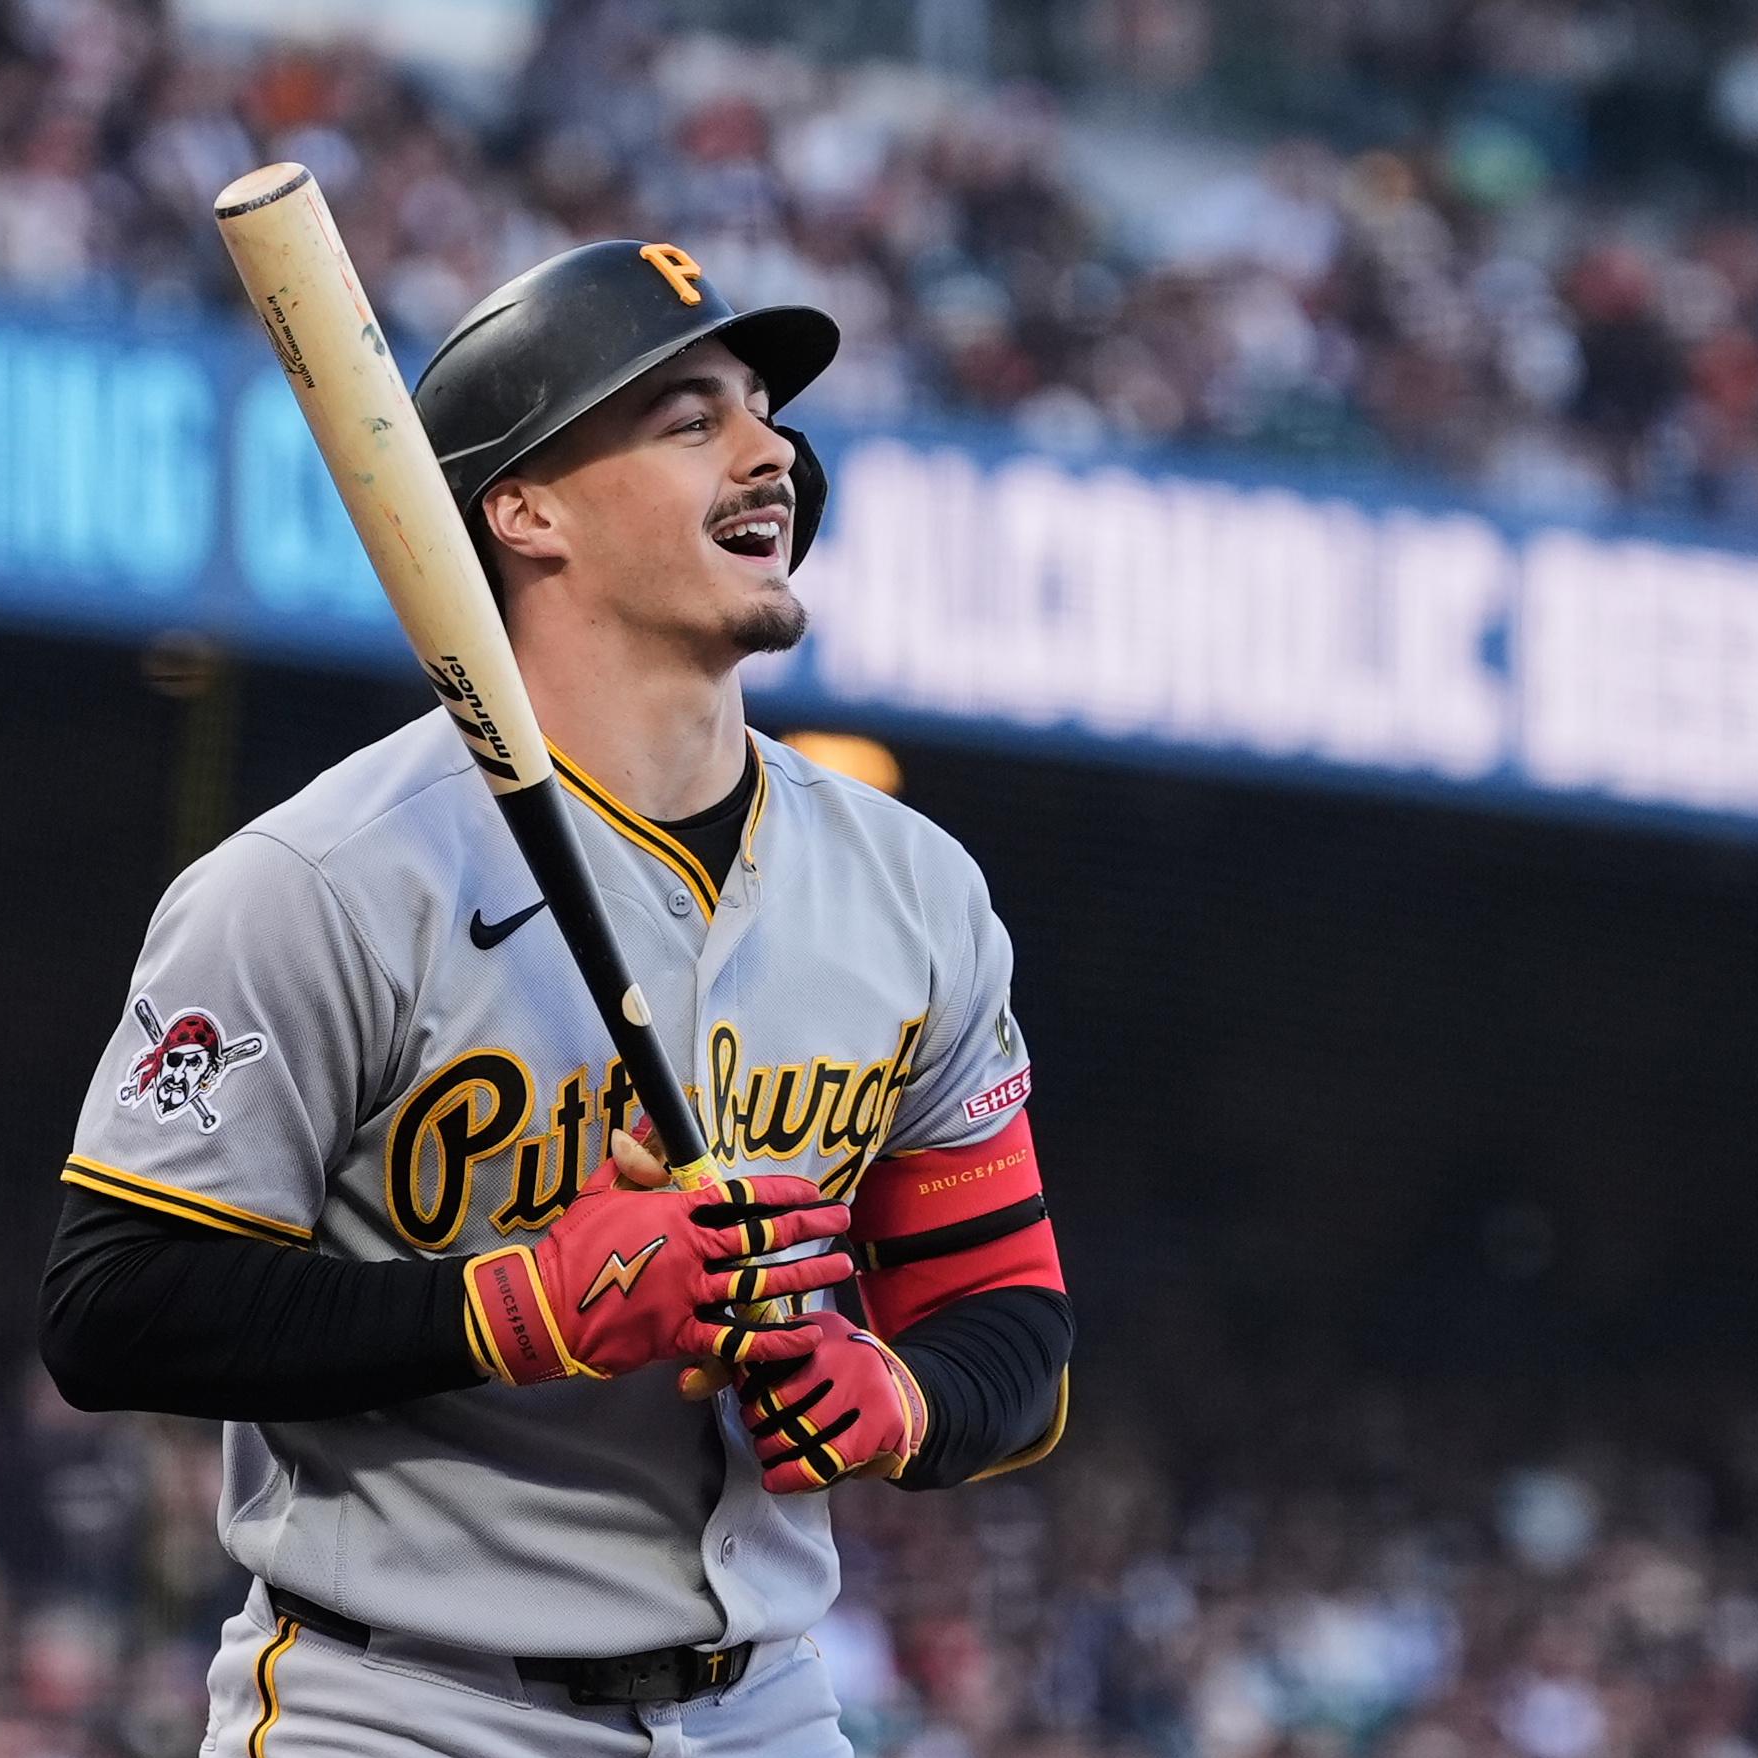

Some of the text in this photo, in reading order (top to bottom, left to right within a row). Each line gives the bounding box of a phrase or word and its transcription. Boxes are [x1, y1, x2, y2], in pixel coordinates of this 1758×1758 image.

[639, 243, 702, 306] P
[283, 325, 303, 362] Custom
[441, 655, 511, 759] marucci
[968, 1067, 1032, 1118] SHEE
[384, 1016, 928, 1253] Pittburgh
[918, 1148, 1028, 1195] BRUCE BOLT
[494, 1265, 539, 1362] BRUCE BOLT
